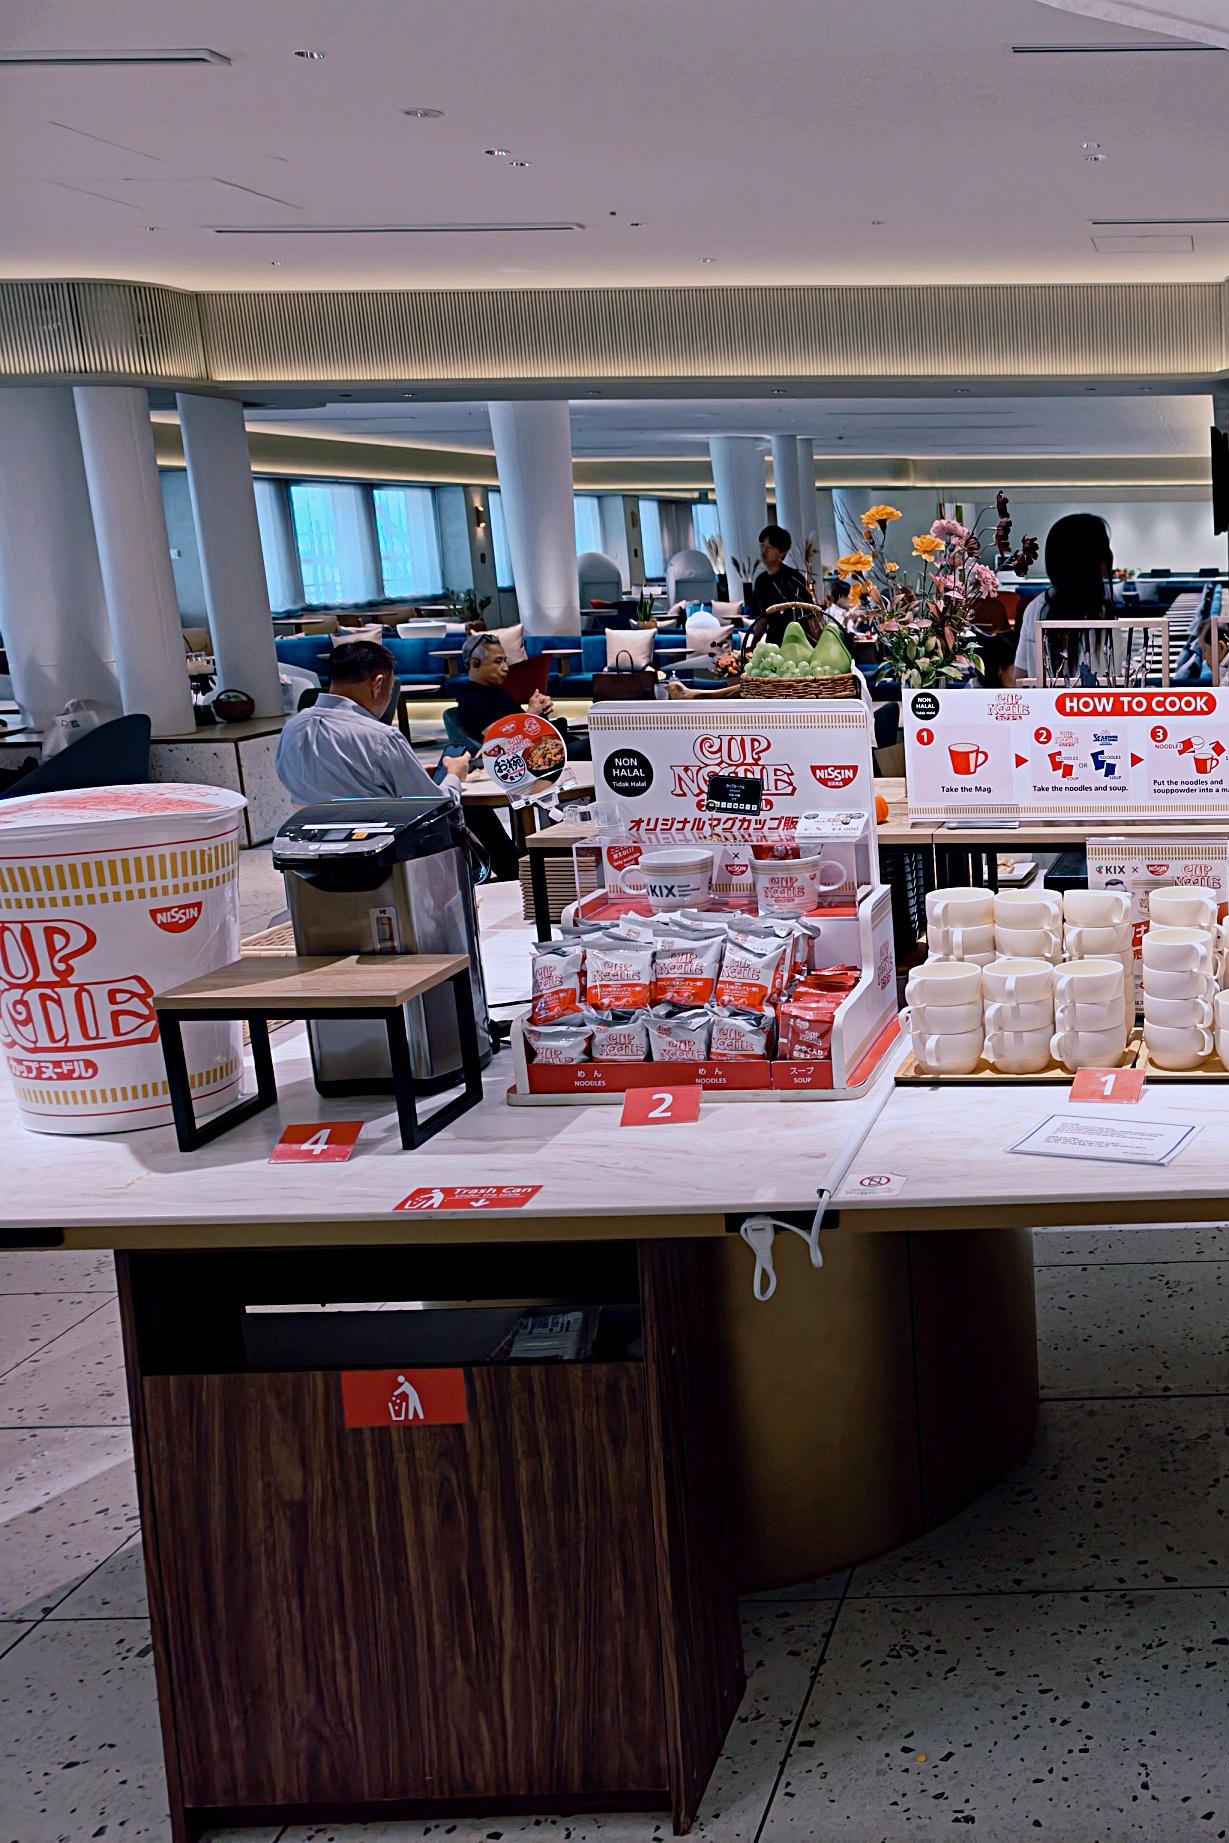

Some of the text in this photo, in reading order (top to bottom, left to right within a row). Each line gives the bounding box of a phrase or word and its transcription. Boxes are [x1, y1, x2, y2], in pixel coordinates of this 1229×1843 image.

[995, 693, 1022, 705] CUP
[1065, 696, 1209, 713] HOW TO COOK
[921, 731, 929, 742] 1
[1039, 730, 1047, 742] 2
[1155, 728, 1163, 740] 3
[693, 734, 771, 764] CUP
[615, 758, 638, 767] NON
[612, 768, 645, 777] HALAL
[816, 766, 855, 780] NISSIN
[941, 785, 993, 795] Take the Mag.
[1109, 786, 1128, 794] soup.
[1153, 787, 1197, 795] souppowder
[628, 817, 803, 832] オリジナルマグカップ販
[1105, 865, 1168, 874] KIX NISSIN
[1181, 864, 1212, 877] CUP
[769, 877, 798, 887] CUP
[649, 885, 676, 897] KIX
[156, 907, 198, 924] NISSIN
[0, 919, 97, 984] UP
[669, 952, 697, 964] CUP
[606, 1033, 635, 1045] CUP
[12, 1060, 93, 1080] カップヌードル
[790, 1067, 815, 1075] スープ
[695, 1077, 727, 1085] NOODLES
[1100, 1074, 1117, 1095] 1
[648, 1093, 674, 1118] 2
[300, 1128, 333, 1155] 4
